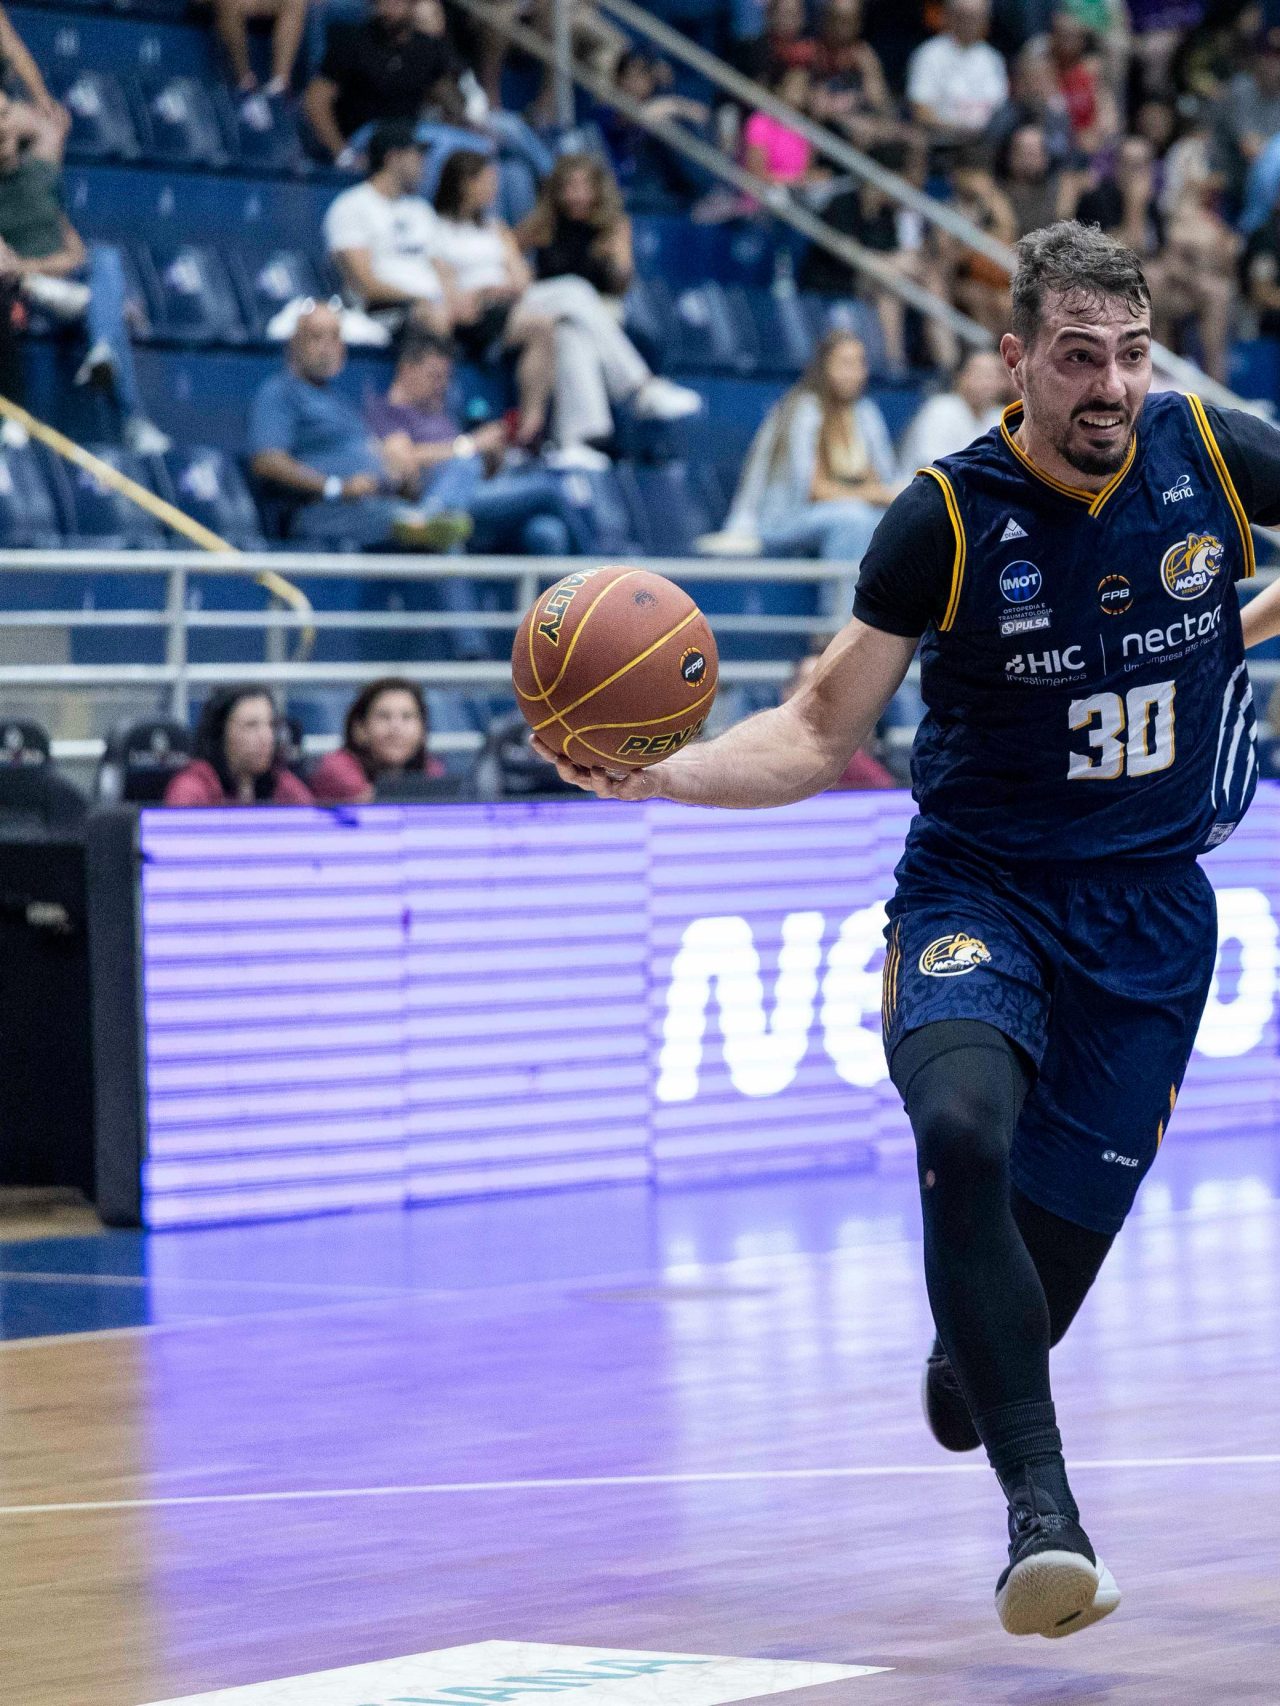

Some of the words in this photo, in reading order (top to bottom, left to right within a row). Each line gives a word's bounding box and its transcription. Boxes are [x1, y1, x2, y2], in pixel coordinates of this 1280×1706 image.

[1003, 573, 1038, 591] IMOT
[1174, 571, 1207, 591] MOGI
[1101, 588, 1130, 602] FPB
[998, 608, 1053, 621] TRAUMATOLOGIA
[1003, 604, 1040, 615] ORTOPEDIA
[1041, 602, 1046, 610] E
[1016, 617, 1049, 632] PULSA
[1122, 603, 1222, 657] necton
[684, 656, 705, 679] FPB
[1027, 645, 1086, 674] HIC
[1067, 679, 1177, 780] 30
